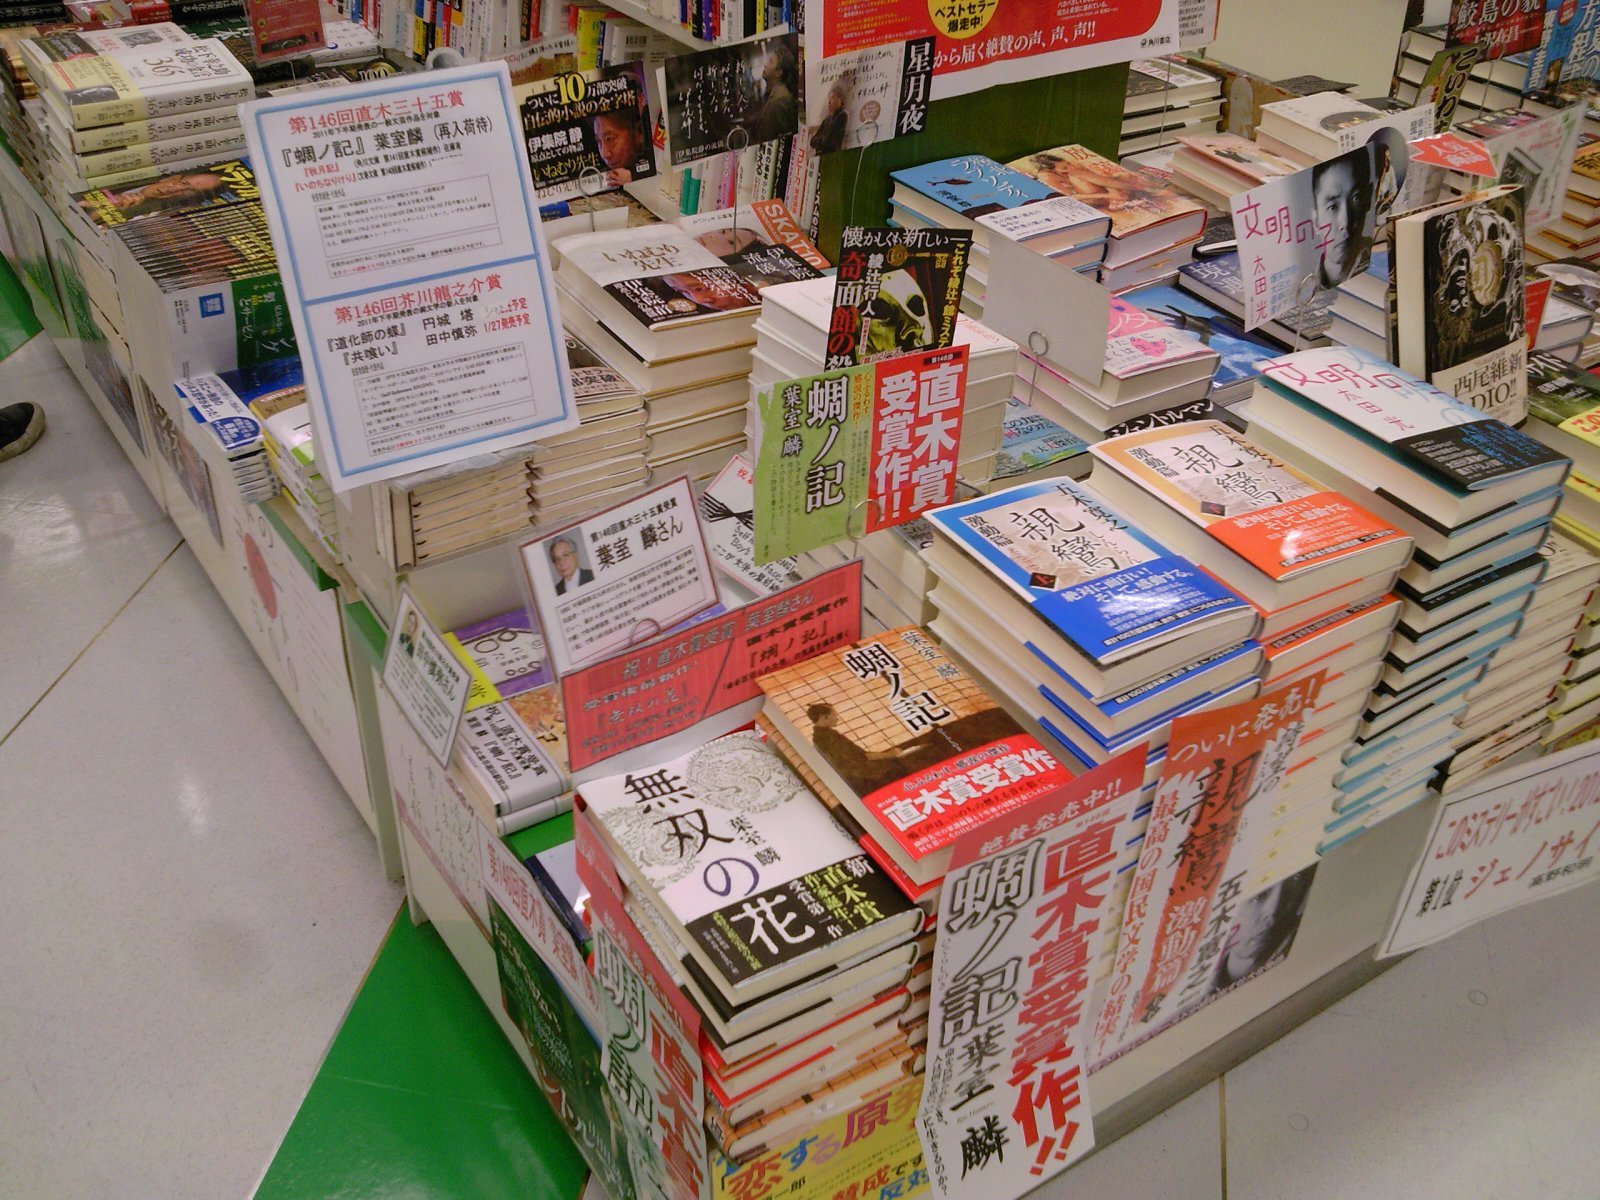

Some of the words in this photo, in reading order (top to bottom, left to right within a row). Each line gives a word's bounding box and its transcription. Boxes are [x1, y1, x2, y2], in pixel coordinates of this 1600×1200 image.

[934, 1, 996, 18] ベストセラー
[947, 16, 985, 34] 爆走中!
[288, 89, 466, 136] 第146回直木三十五賞
[523, 89, 636, 131] 自伝的小説の金字塔
[899, 40, 932, 135] 星月夜
[281, 135, 366, 168] 『蜩ノ記』
[373, 126, 424, 152] 葉室麟
[527, 129, 569, 154] 伊集院
[568, 126, 583, 143] 静
[533, 151, 601, 182] いねむり先生
[1236, 194, 1335, 260] 文明の子
[333, 273, 504, 325] 第146回芥川龍之介賞
[861, 251, 885, 317] 綾辻行人
[1253, 256, 1268, 324] 太田光
[326, 321, 407, 353] 『道化師の蝶』
[422, 313, 451, 331] 円城
[459, 308, 475, 324] 塔
[342, 341, 399, 367] 『共喰い』
[483, 313, 532, 334] 1/27発売予定
[1453, 349, 1524, 398] 西尾維新
[781, 384, 804, 432] 葉室
[1110, 400, 1215, 439] ジェントルマン
[781, 435, 804, 458] 麟
[804, 375, 849, 515] 蜩ノ記
[907, 362, 964, 514] 直木賞
[1129, 447, 1180, 478] 激動篇
[1208, 424, 1285, 469] 五木寛之
[1170, 444, 1285, 507] 親鸞
[963, 514, 1013, 548] 激動篇
[1053, 482, 1129, 532] 五木寛之
[595, 537, 634, 572] 葉室
[640, 514, 684, 553] 麟さん
[1010, 507, 1121, 576] 親鸞
[1061, 566, 1154, 603] 絶対に面白い!
[745, 596, 850, 648] 直木賞受賞作
[842, 643, 953, 733] 蜩ノ記
[1171, 678, 1317, 762] ついに発売!
[882, 746, 1061, 833] 直木賞受賞作
[976, 776, 1122, 858] 絶賛発売中!!
[1166, 749, 1263, 894] 親鸞
[622, 767, 817, 954] 無双の花
[844, 855, 876, 879] 新
[823, 863, 886, 926] 直木賞
[938, 836, 1046, 1051] 蜩ノ記
[1007, 811, 1129, 1178] 直木賞受賞作!!
[949, 1024, 1008, 1113] 葉室
[959, 1115, 1011, 1182] 麟
